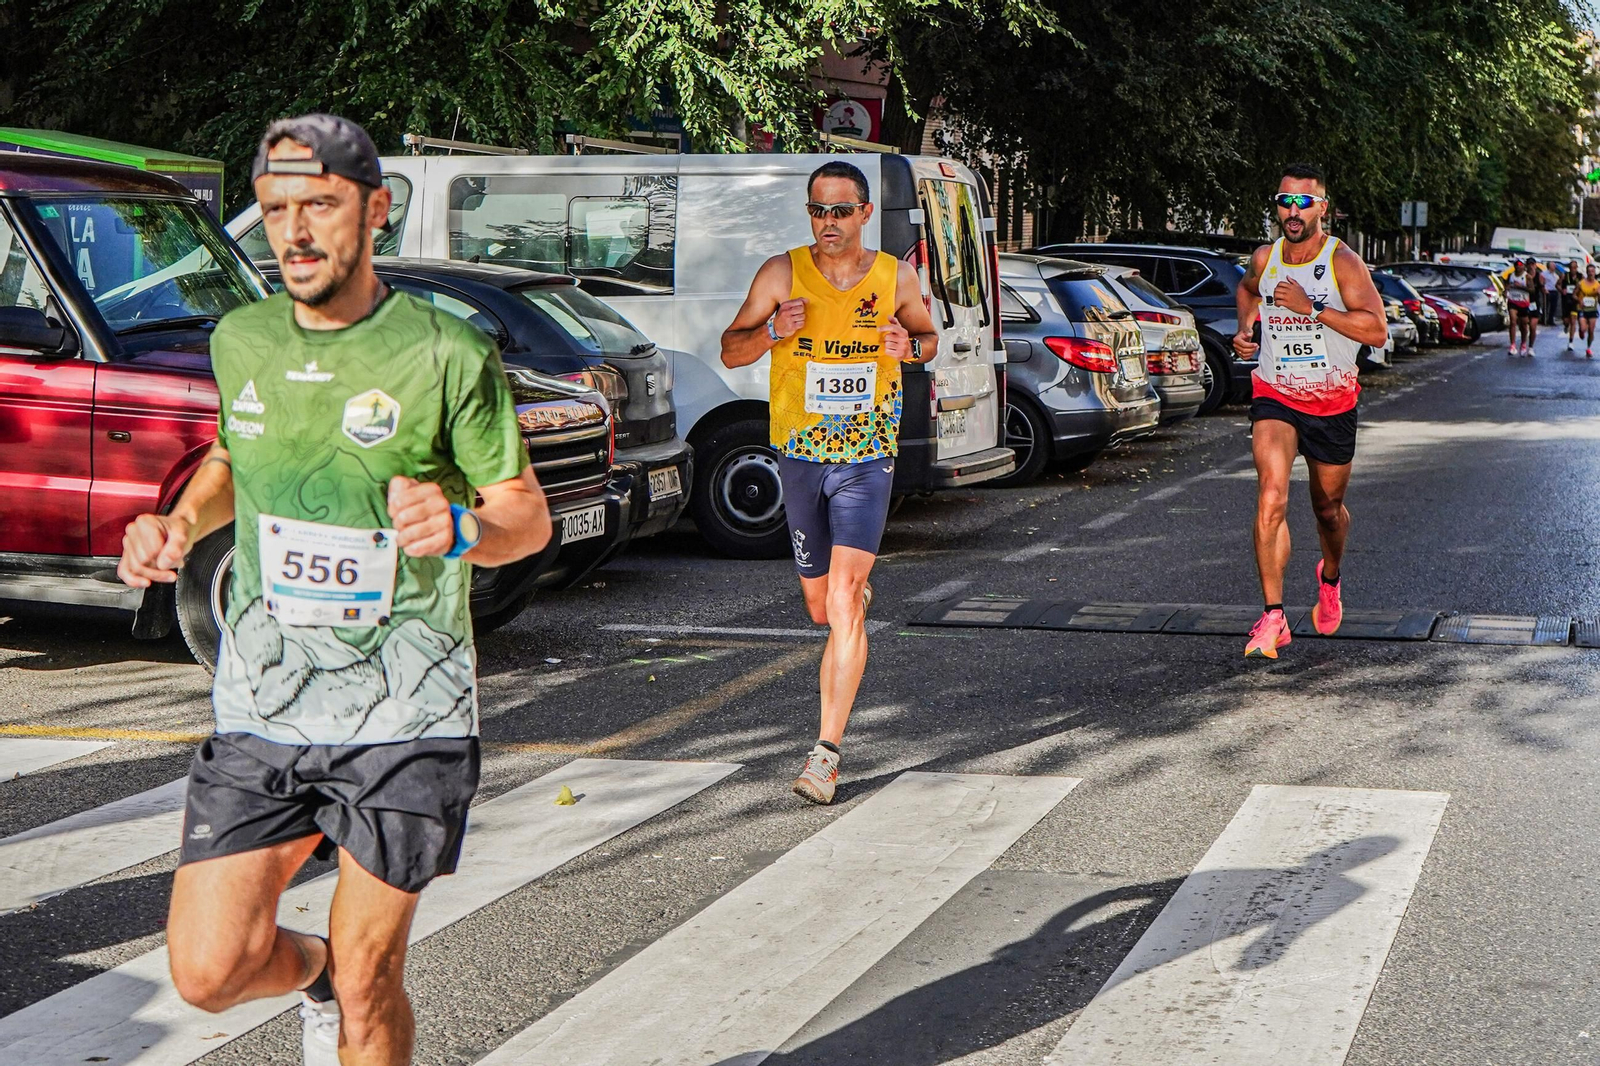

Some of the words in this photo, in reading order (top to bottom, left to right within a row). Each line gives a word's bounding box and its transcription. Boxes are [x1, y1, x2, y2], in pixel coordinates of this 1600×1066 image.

[793, 351, 816, 360] SEAT
[824, 340, 880, 358] Vigilsa
[1283, 343, 1313, 356] 165
[816, 377, 867, 394] 1380
[525, 409, 560, 424] LAND
[564, 403, 600, 419] ROVER
[282, 550, 359, 585] 556
